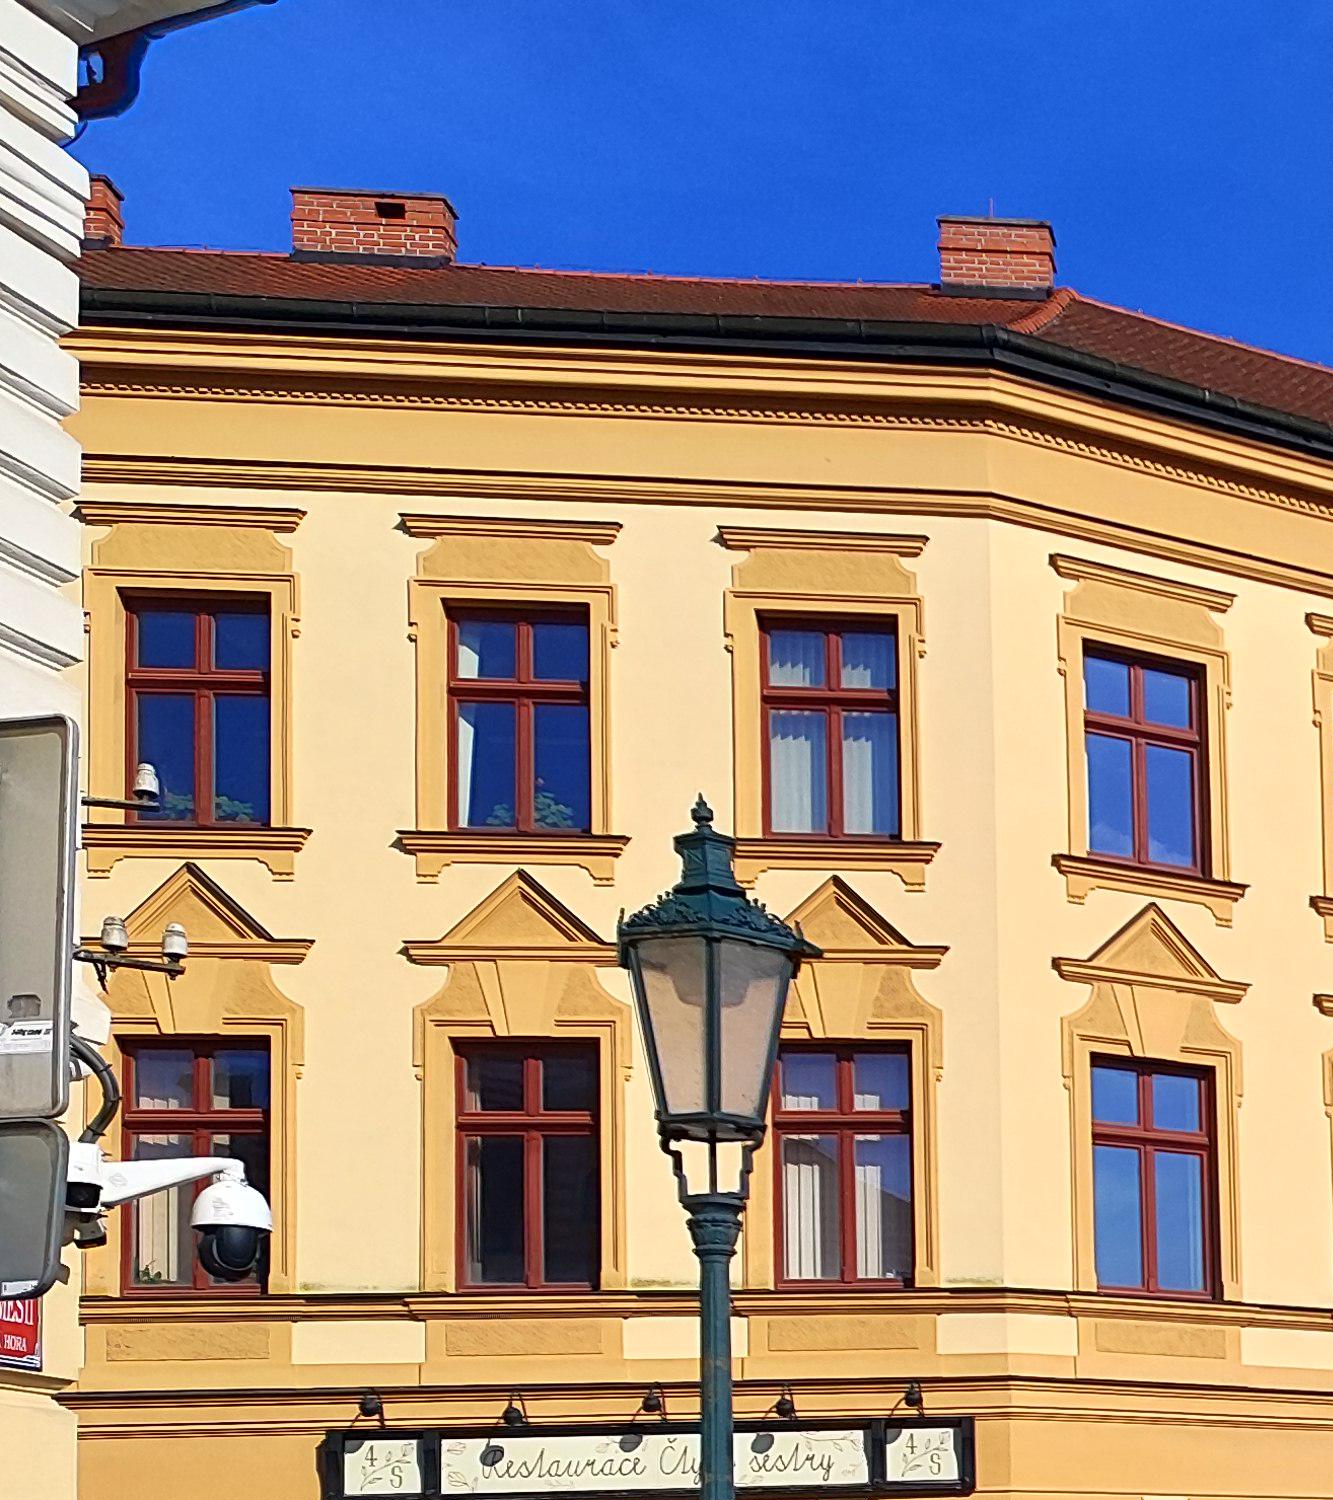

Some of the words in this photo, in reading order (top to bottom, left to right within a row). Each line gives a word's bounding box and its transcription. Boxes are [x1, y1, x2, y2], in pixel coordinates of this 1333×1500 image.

[4, 1334, 27, 1352] HORA
[365, 1445, 377, 1467] 4
[389, 1465, 403, 1489] S
[481, 1445, 647, 1480] Restaurace
[750, 1442, 834, 1482] sestry
[905, 1433, 917, 1454] 4
[929, 1453, 941, 1475] S
